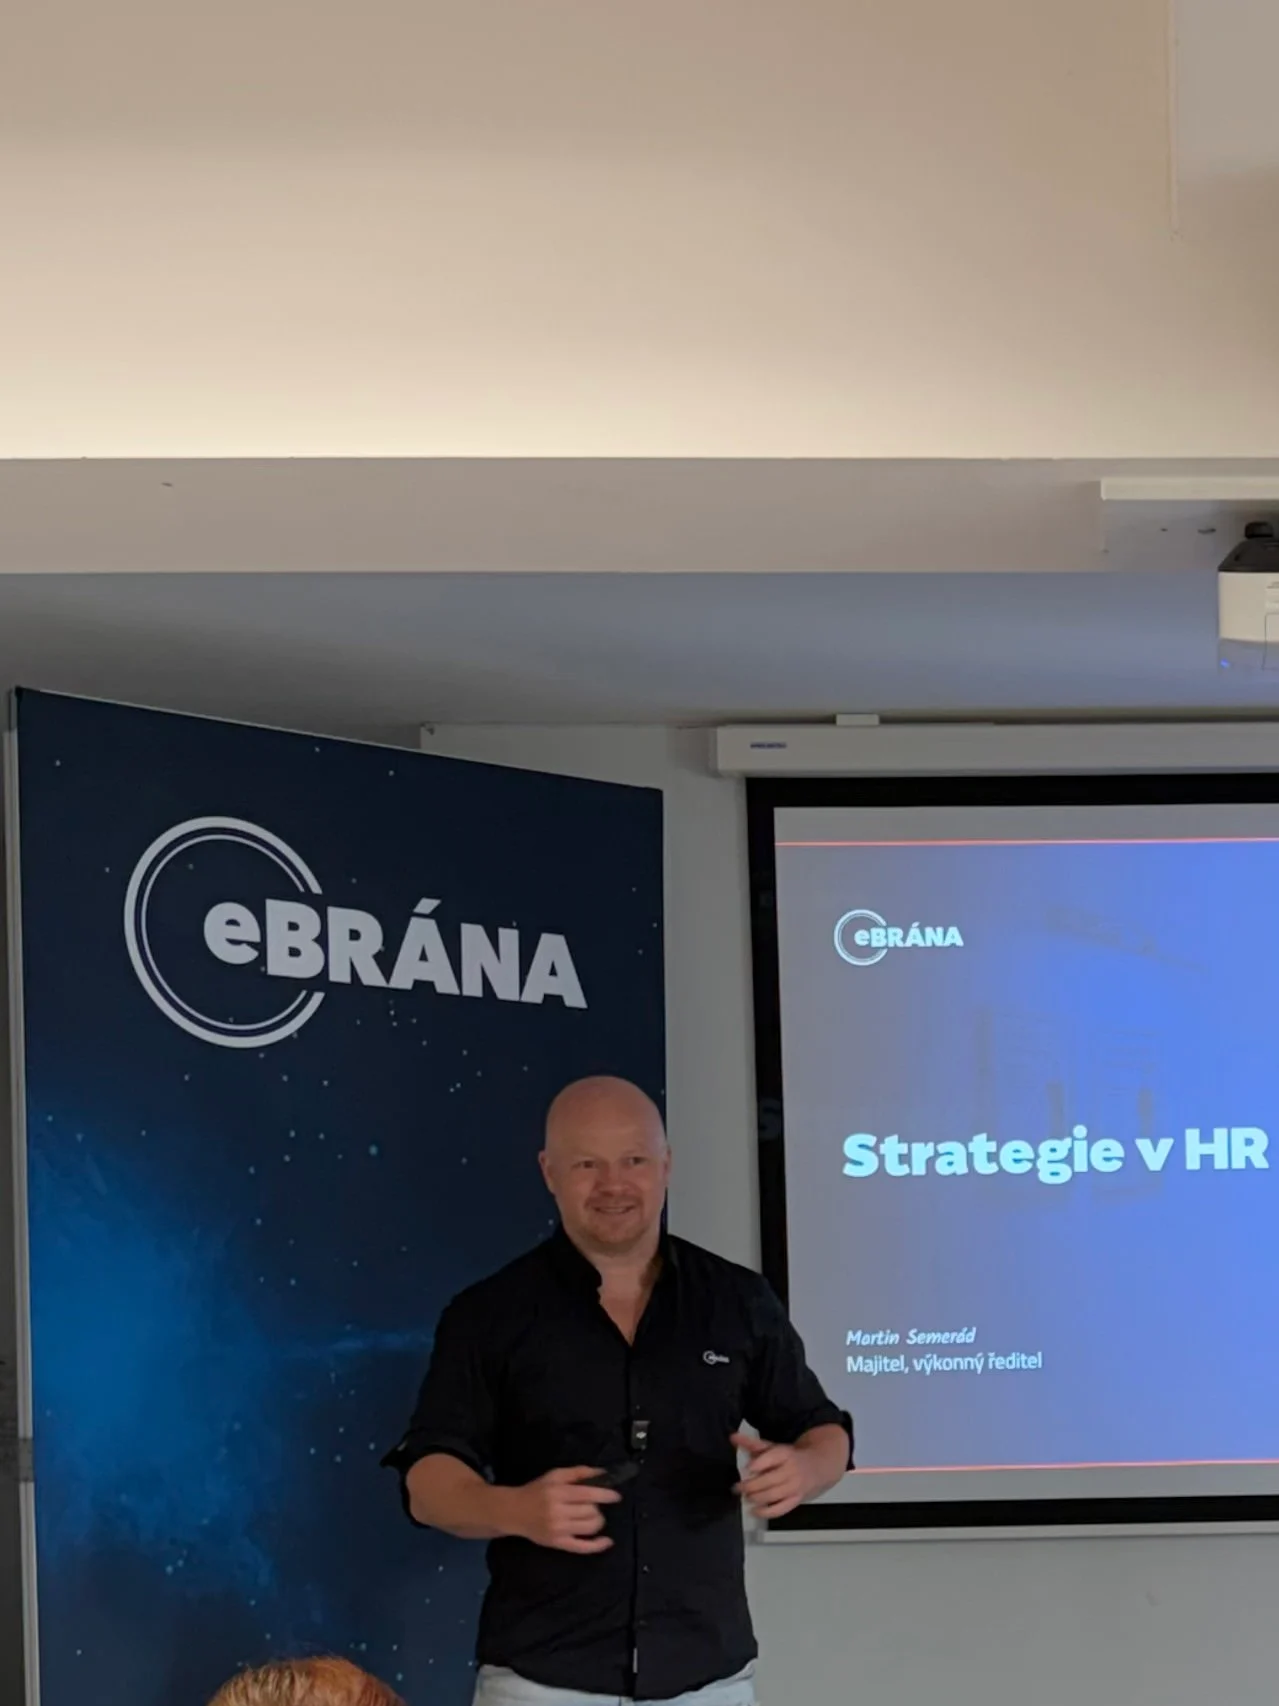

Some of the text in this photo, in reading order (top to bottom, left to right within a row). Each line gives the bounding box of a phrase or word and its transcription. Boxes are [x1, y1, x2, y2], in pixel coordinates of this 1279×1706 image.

[853, 921, 964, 947] eBRÁNA
[203, 897, 588, 1009] eBRÁNA
[842, 1125, 1269, 1184] Strategie v HR
[846, 1327, 977, 1346] Martin Semerád
[847, 1351, 1043, 1376] Majitel, výkonný ředitel
